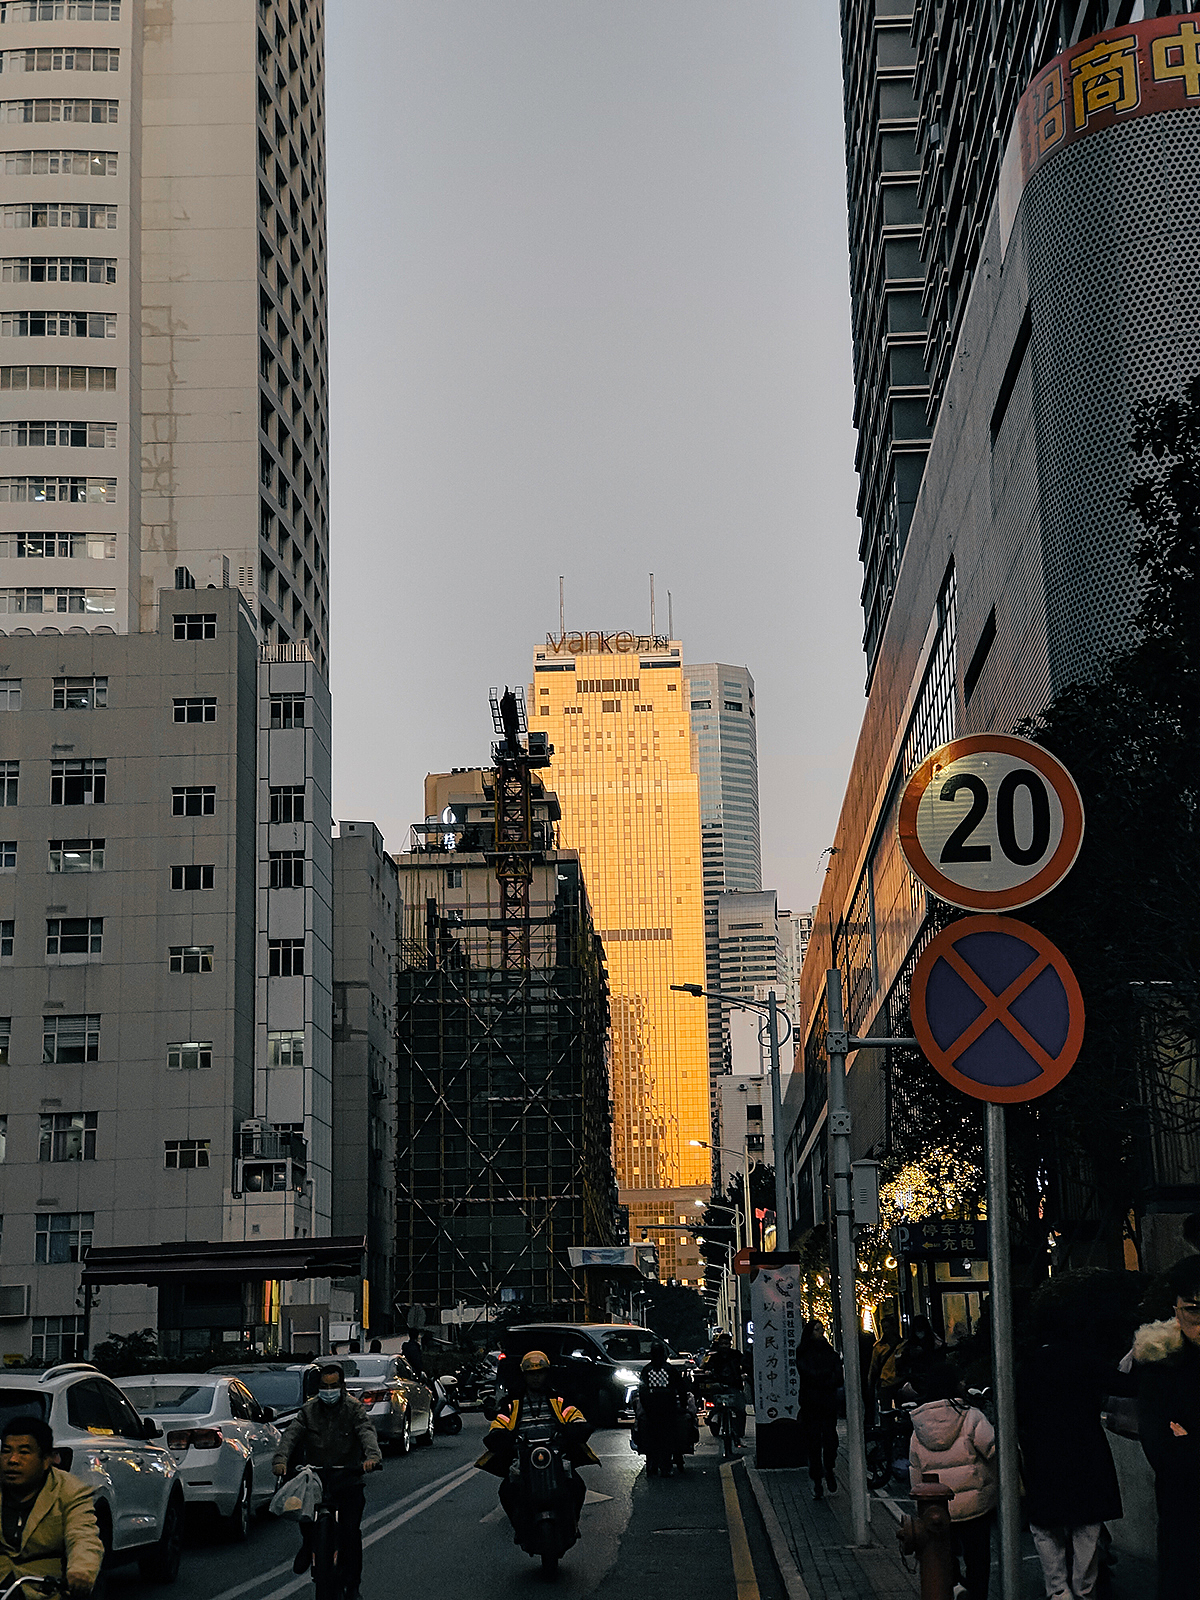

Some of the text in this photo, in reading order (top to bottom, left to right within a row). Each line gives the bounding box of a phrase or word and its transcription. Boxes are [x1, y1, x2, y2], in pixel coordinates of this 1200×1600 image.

[546, 630, 669, 654] vanke 万科
[939, 769, 1051, 866] 20
[922, 1223, 975, 1236] 停车场
[943, 1238, 976, 1251] 充电
[762, 1301, 780, 1403] 以人民为中心
